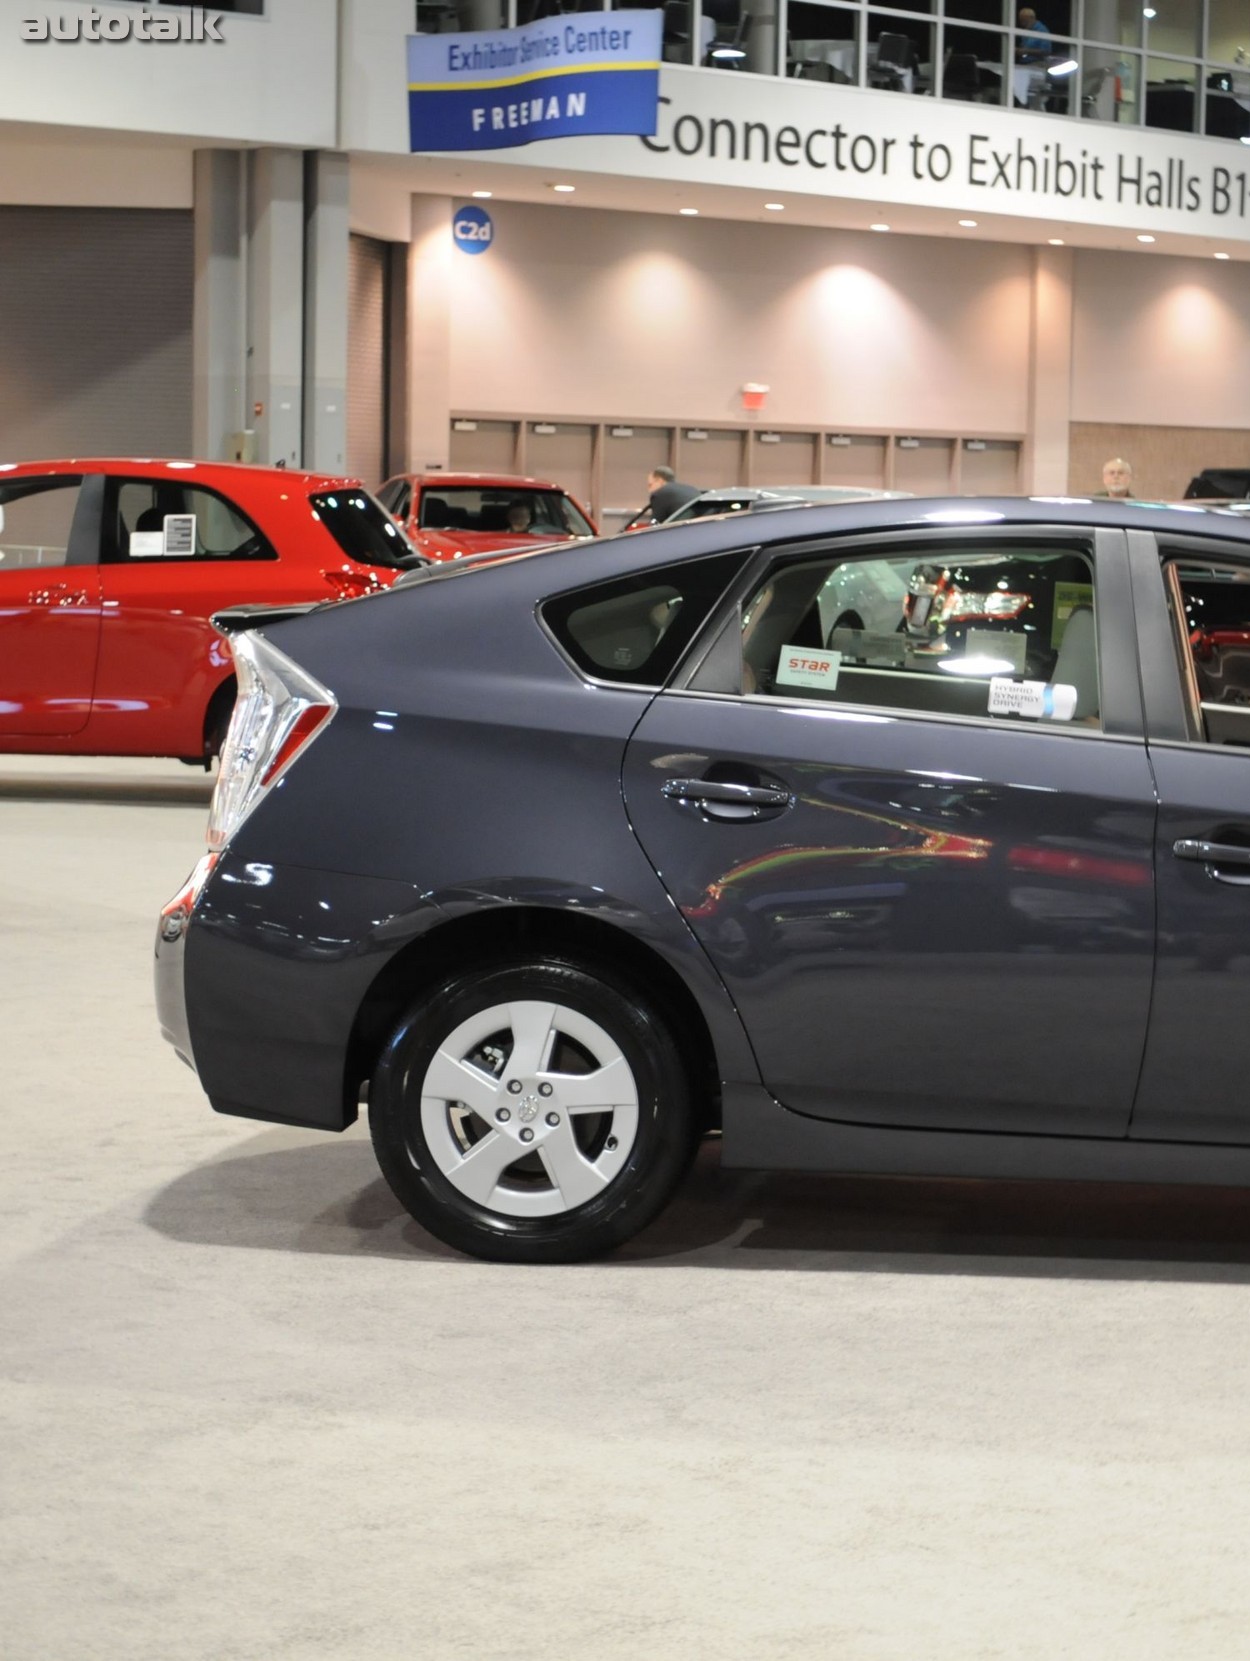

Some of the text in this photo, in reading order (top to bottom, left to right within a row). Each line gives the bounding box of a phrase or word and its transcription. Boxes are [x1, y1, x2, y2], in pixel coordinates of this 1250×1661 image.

[448, 42, 518, 72] Exhibitor
[564, 25, 632, 55] Center
[471, 92, 587, 132] FREEMAN
[909, 134, 952, 182] to
[967, 134, 1104, 201] Exhibit
[1117, 153, 1201, 212] Halls
[454, 220, 491, 241] C2d
[994, 692, 1040, 703] SYNERGY
[995, 684, 1033, 695] HYBRID
[993, 699, 1023, 708] DRIVE
